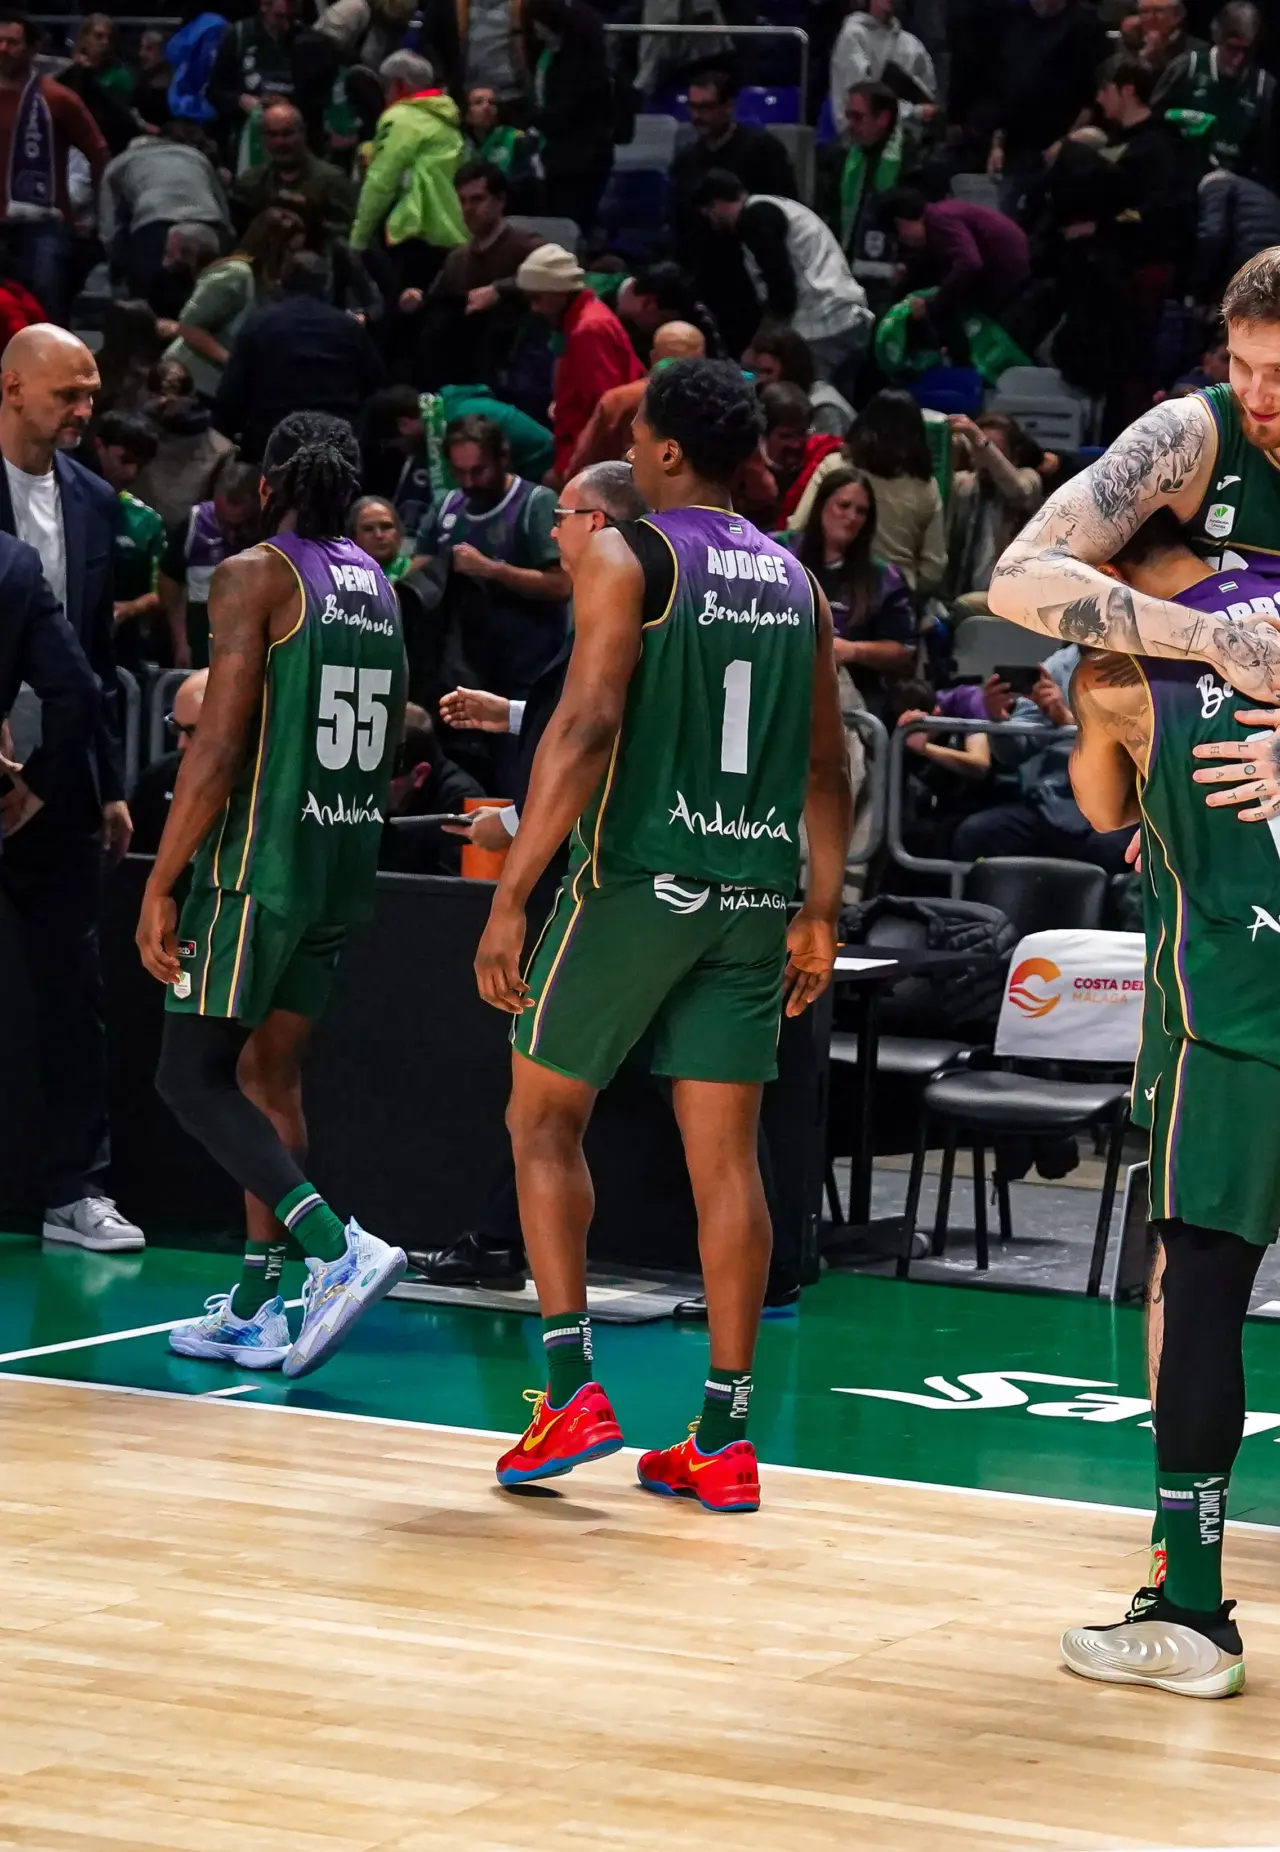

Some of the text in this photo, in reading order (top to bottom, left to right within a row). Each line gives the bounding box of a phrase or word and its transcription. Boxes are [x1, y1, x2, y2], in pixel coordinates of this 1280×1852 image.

[316, 664, 393, 772] 55
[720, 659, 752, 775] 1
[1073, 977, 1118, 990] COSTA
[1198, 1490, 1221, 1545] UNICAJA
